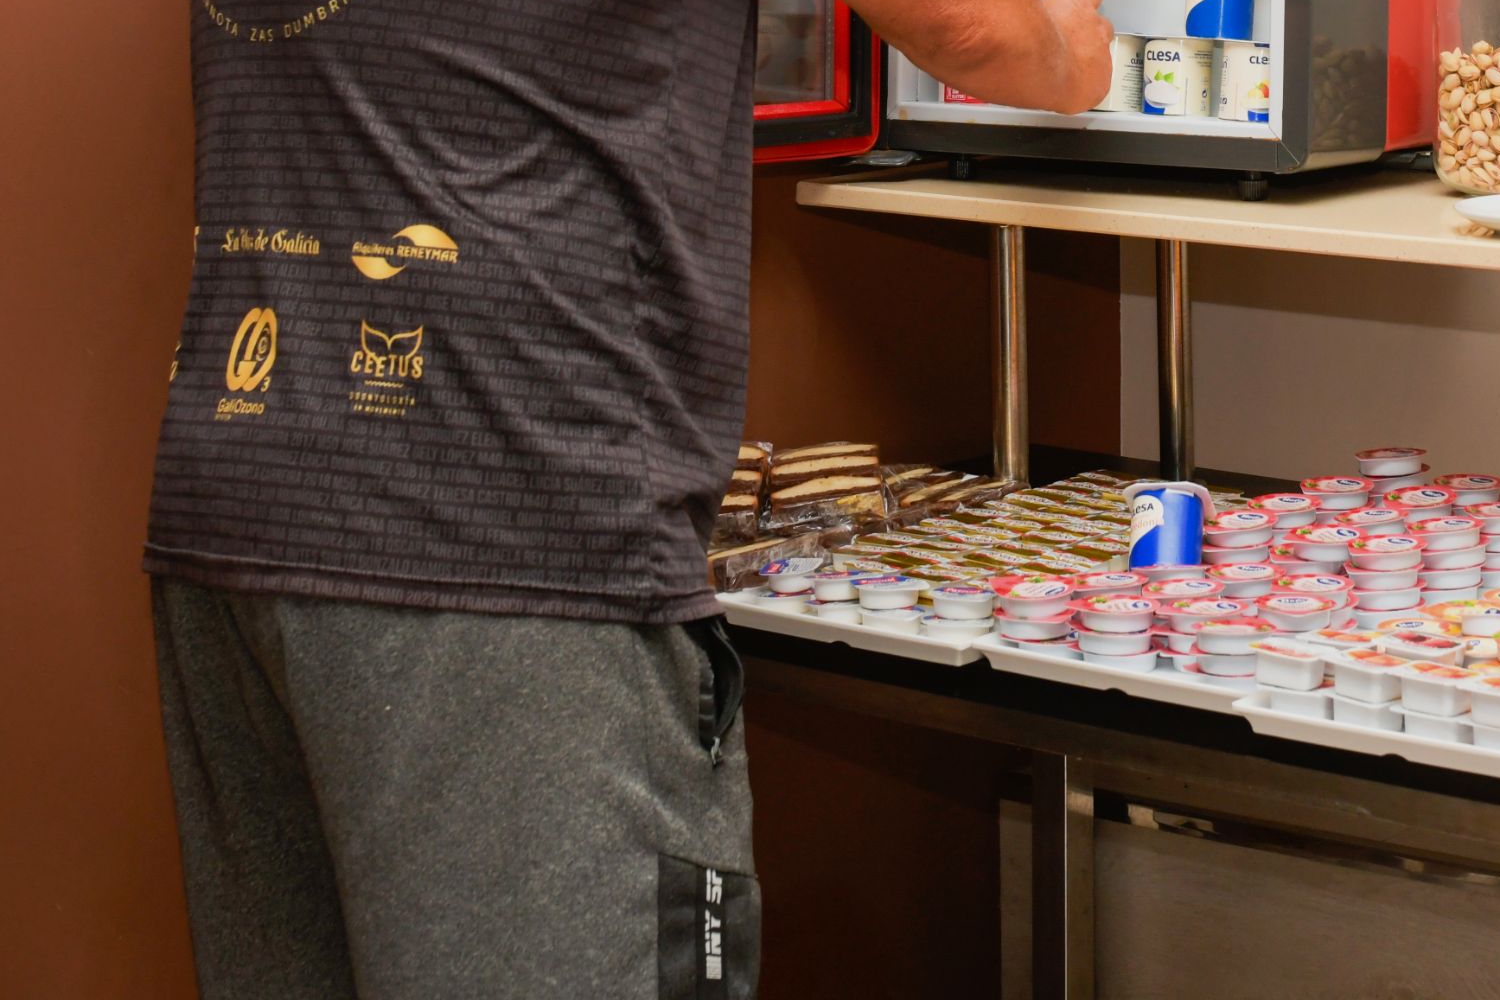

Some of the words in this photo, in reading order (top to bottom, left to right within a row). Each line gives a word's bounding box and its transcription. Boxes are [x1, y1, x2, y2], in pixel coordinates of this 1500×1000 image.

[250, 28, 274, 42] ZAS
[255, 228, 269, 251] de
[271, 229, 320, 255] Galicia
[397, 245, 459, 264] RENEYMAR
